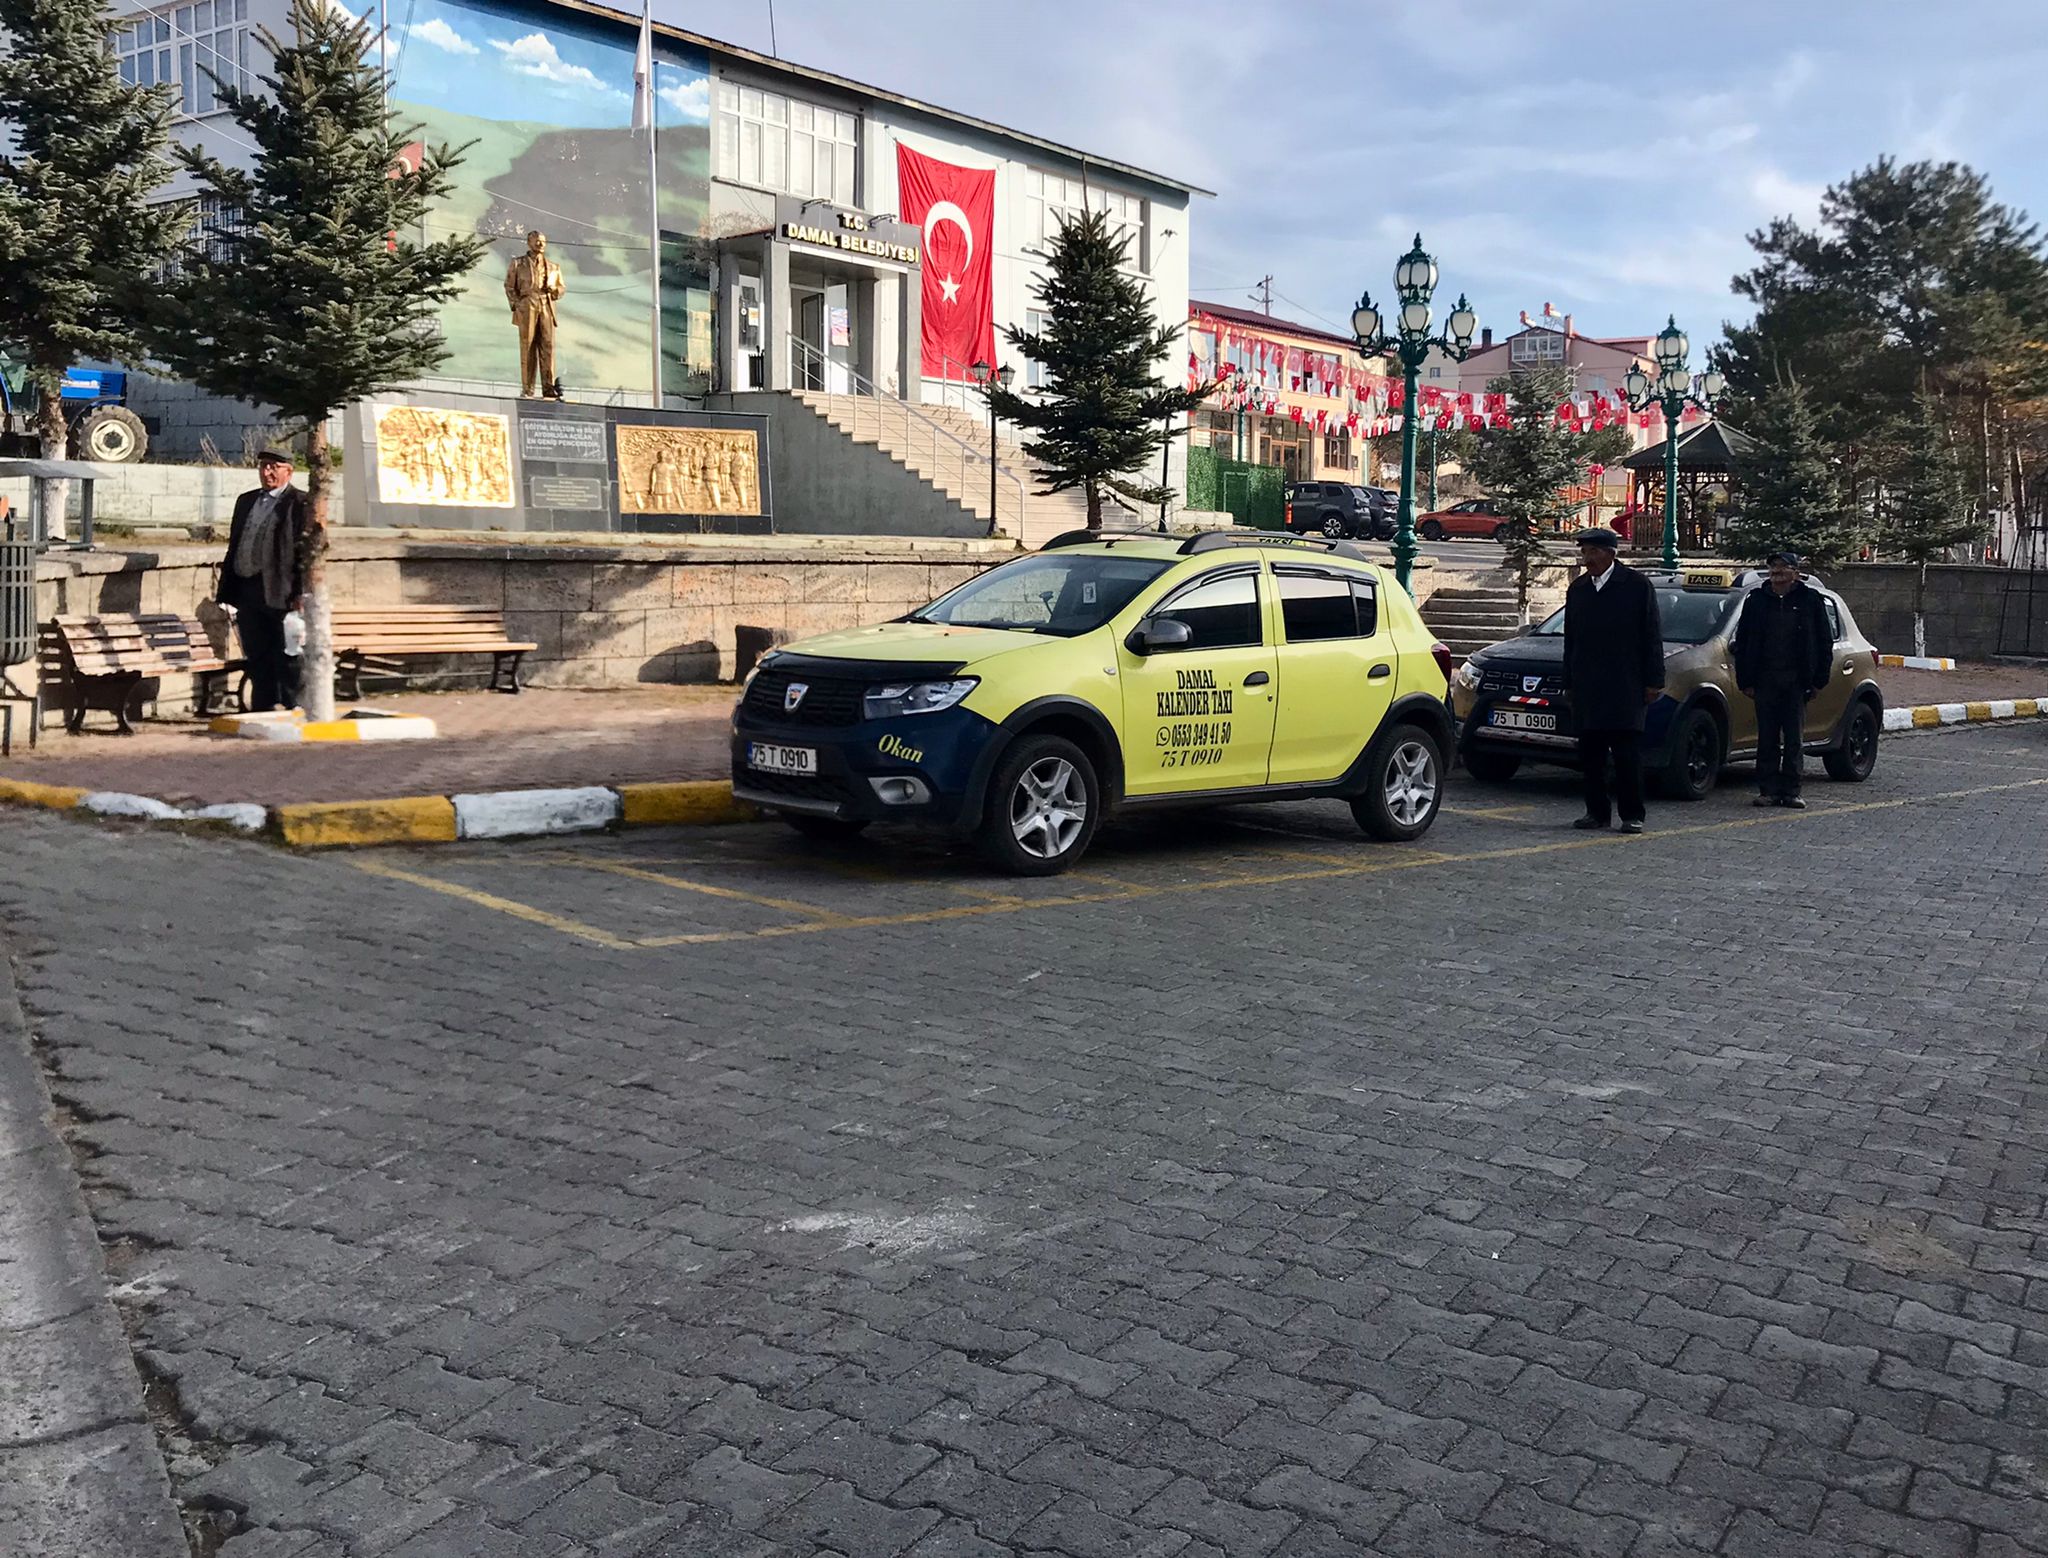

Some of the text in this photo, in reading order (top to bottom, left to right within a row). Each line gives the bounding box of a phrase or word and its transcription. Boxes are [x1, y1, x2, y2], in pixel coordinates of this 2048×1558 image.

[841, 211, 868, 232] T.C.
[787, 222, 919, 263] DAMAL BELEDİYESİ
[1176, 670, 1217, 690] DAMAL
[1157, 690, 1233, 717] KALENDER TAXI
[1494, 713, 1554, 728] 75 T 0900
[1171, 721, 1232, 748] 0553 349 41 50
[752, 744, 808, 769] 75 T 0910
[878, 733, 924, 763] Okan
[1161, 748, 1222, 768] 75 T 0910
